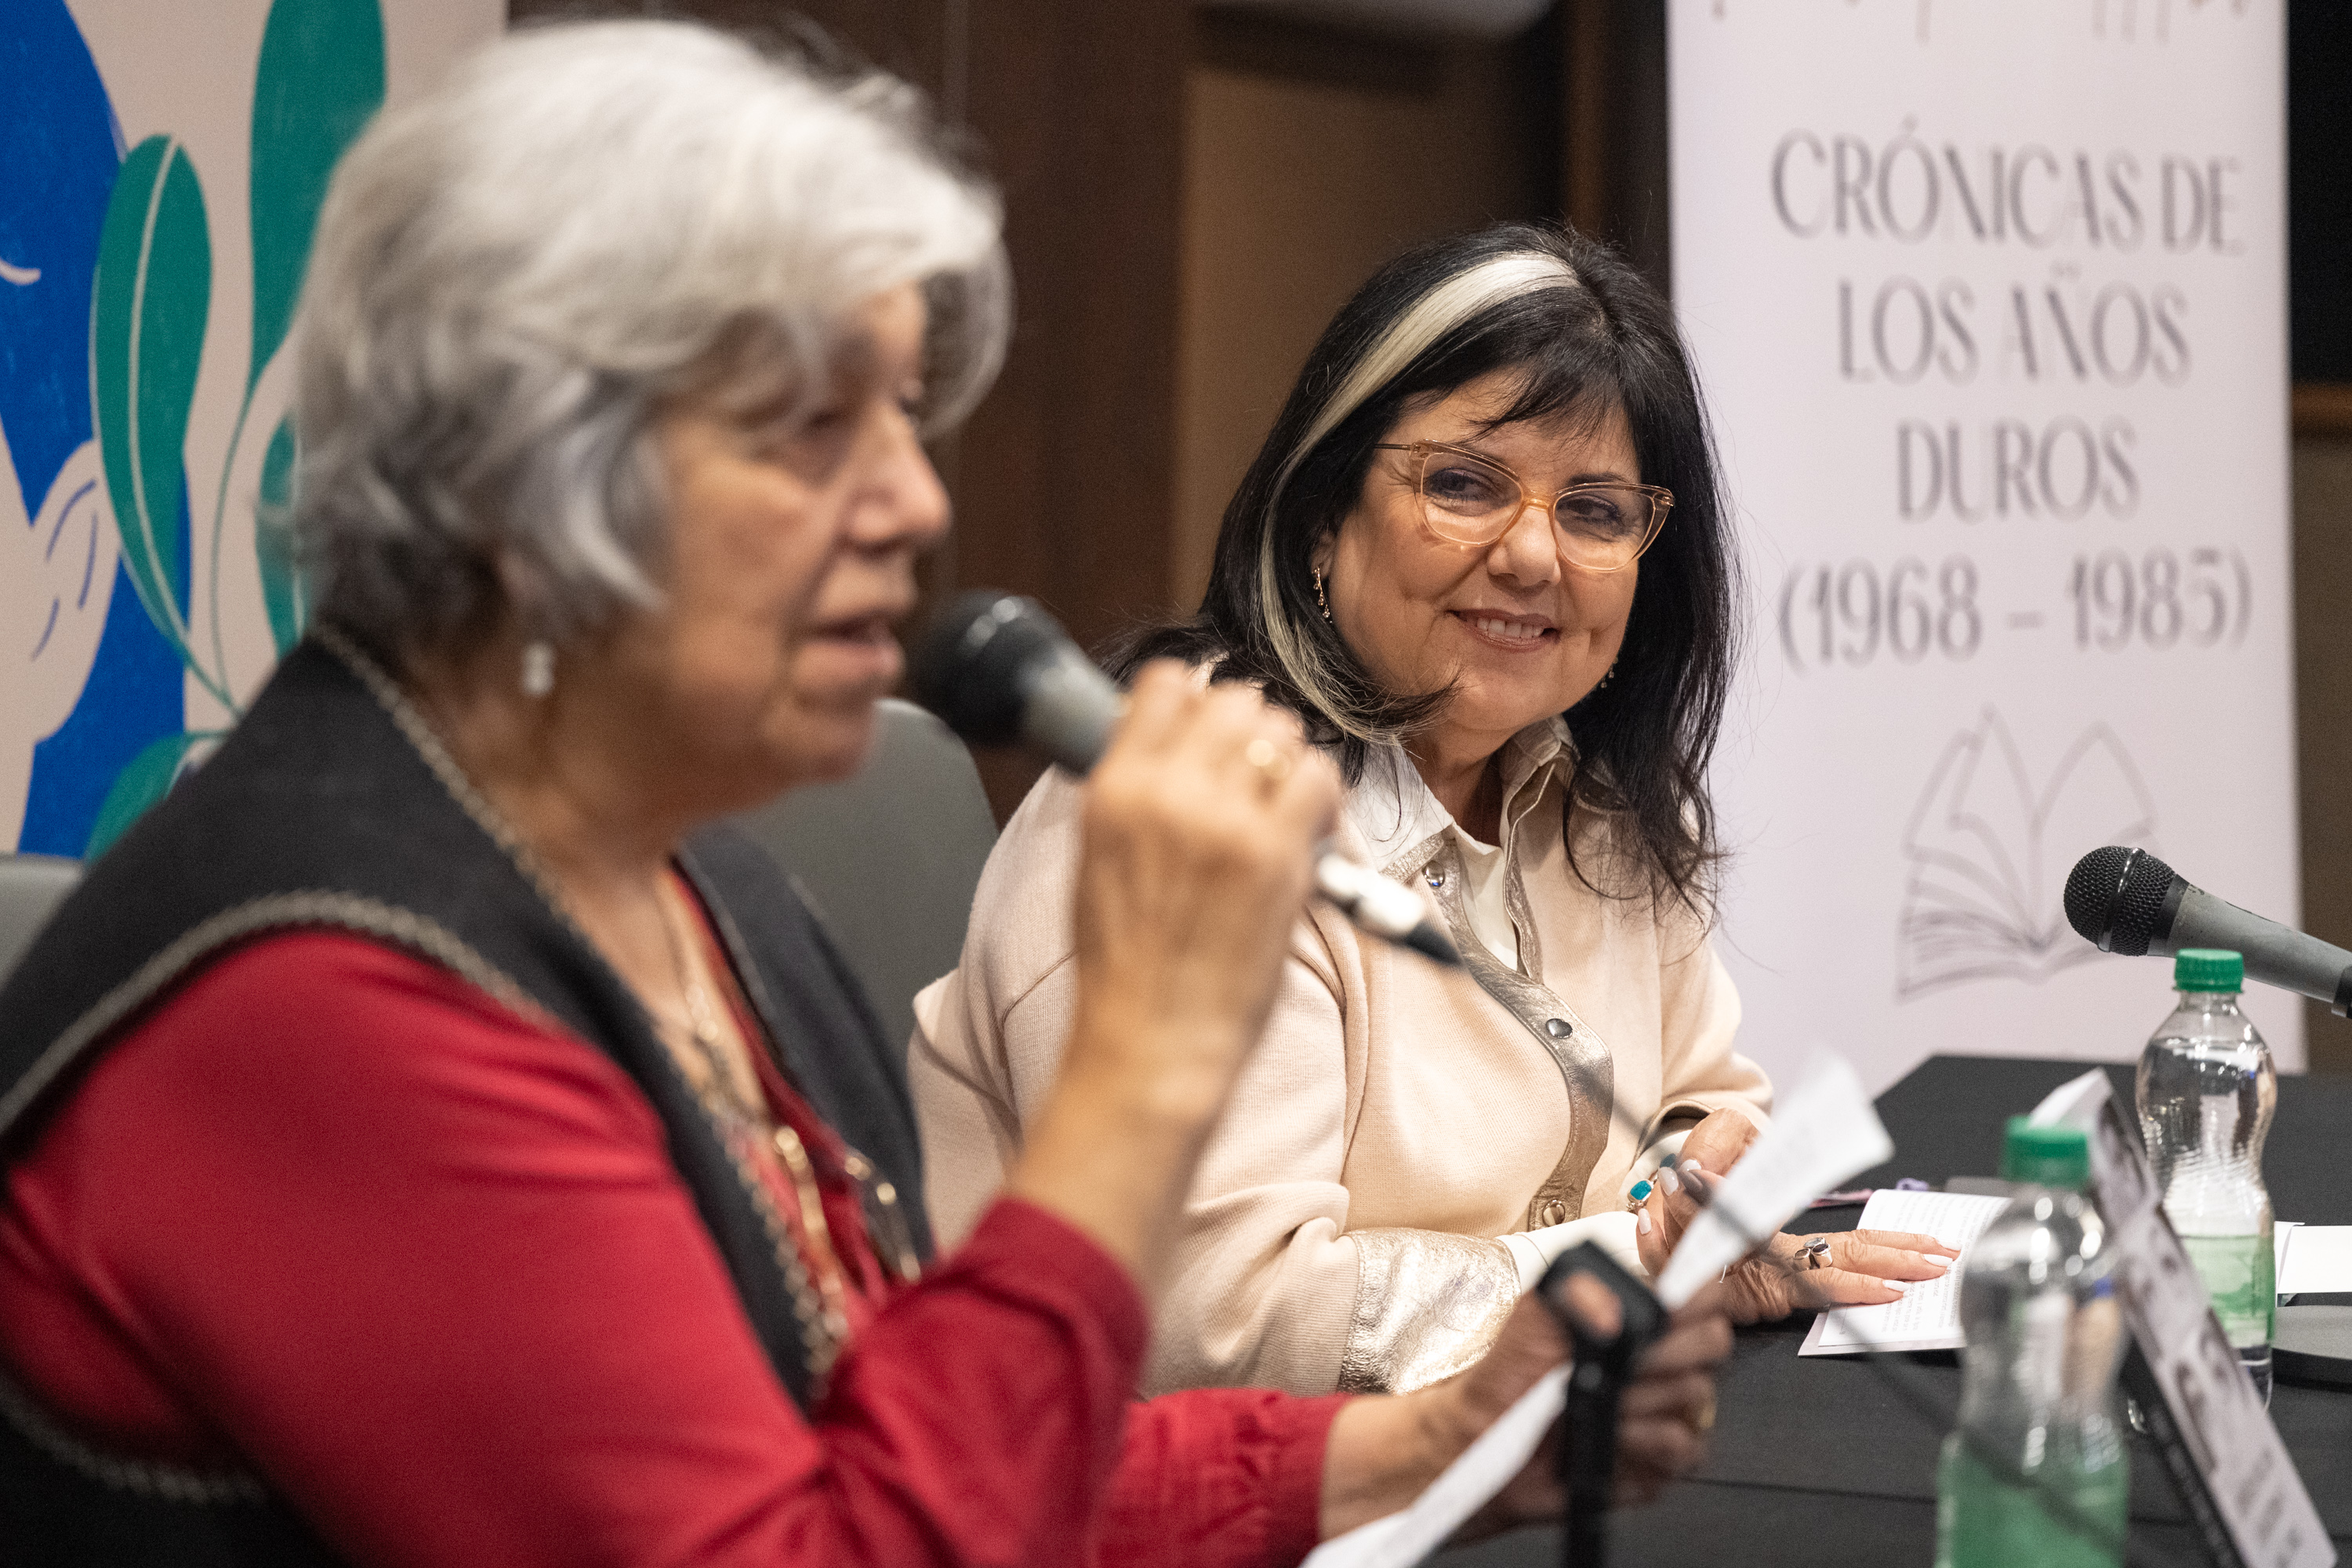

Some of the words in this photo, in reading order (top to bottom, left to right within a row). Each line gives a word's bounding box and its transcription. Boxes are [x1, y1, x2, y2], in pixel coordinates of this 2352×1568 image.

[1770, 115, 2143, 252] CRÓNICAS
[2161, 154, 2245, 256] DE
[1838, 274, 1979, 387] LOS
[2007, 263, 2192, 387] AÑOS
[1896, 414, 2140, 523] DUROS
[1779, 553, 1983, 673] (1968
[2067, 544, 2253, 652] 1985)
